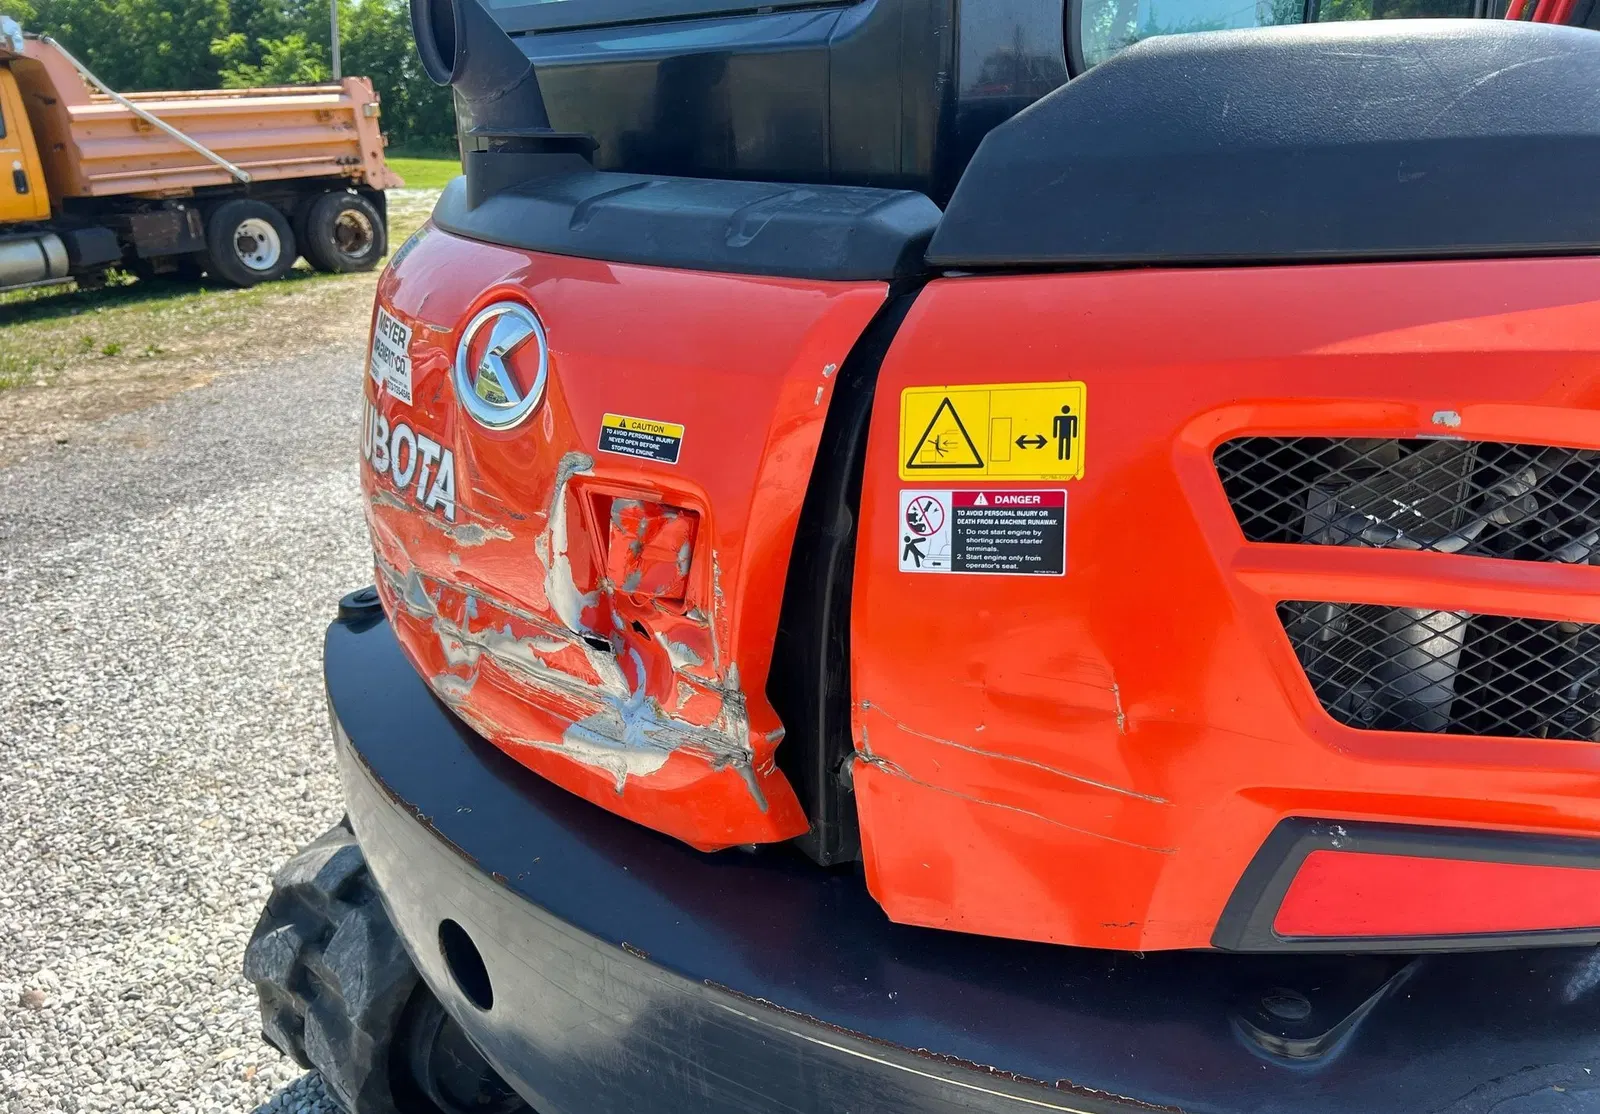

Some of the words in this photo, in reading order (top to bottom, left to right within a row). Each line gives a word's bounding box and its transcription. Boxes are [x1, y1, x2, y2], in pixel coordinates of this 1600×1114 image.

[378, 310, 407, 350] MEYER
[394, 355, 408, 377] CO.
[631, 421, 665, 434] CAUTION
[608, 436, 625, 444] NEVER
[639, 441, 660, 450] BEFORE
[613, 429, 628, 437] AVOID
[628, 431, 655, 442] PERSONAL
[655, 436, 675, 445] INJURY
[611, 444, 635, 454] STOPPING
[635, 447, 655, 457] ENGINE
[994, 495, 1041, 505] DANGER
[1032, 529, 1042, 537] by
[966, 537, 994, 545] shorting
[966, 562, 1000, 570] operator's
